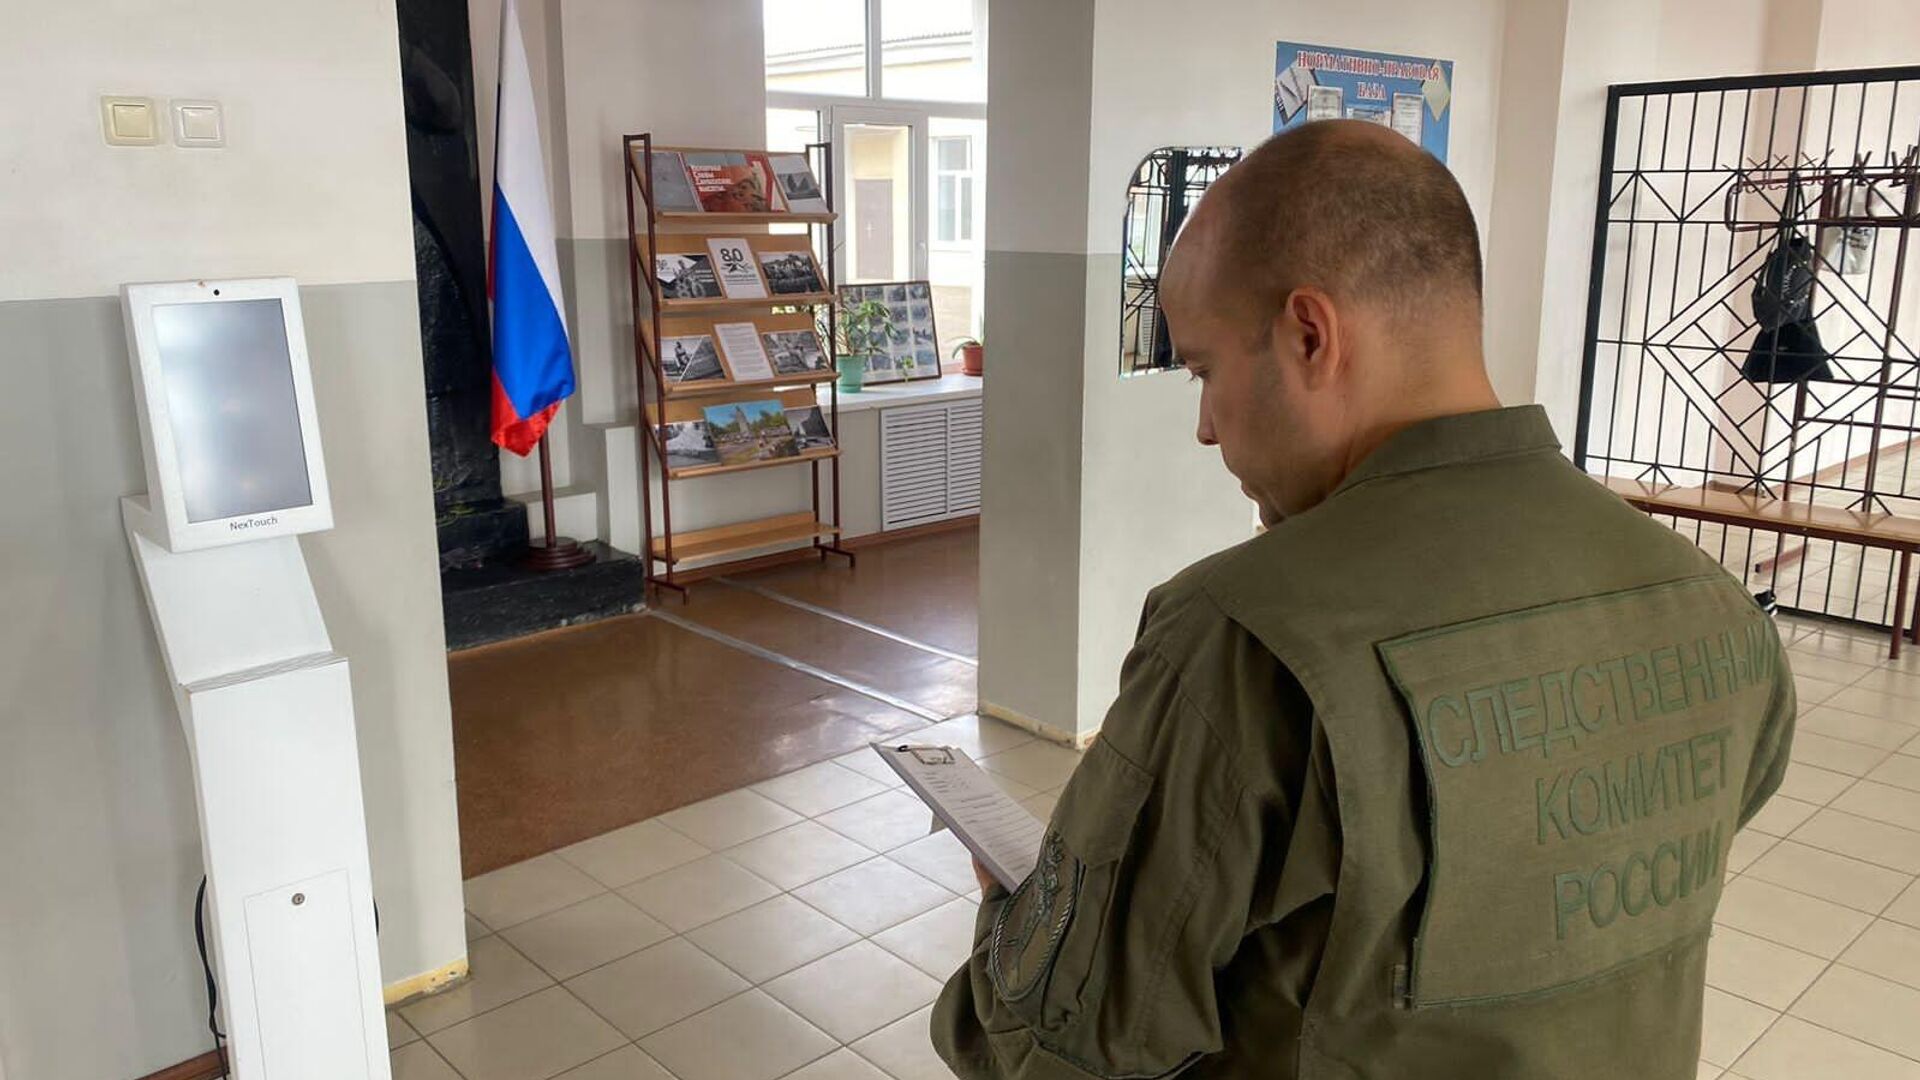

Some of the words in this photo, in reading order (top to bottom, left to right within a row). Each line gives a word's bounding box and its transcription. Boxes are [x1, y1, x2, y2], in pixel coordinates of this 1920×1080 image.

[230, 517, 278, 531] NexTouch
[1536, 729, 1733, 844] КОМИТЕТ
[1554, 824, 1721, 940] РОССИИ
